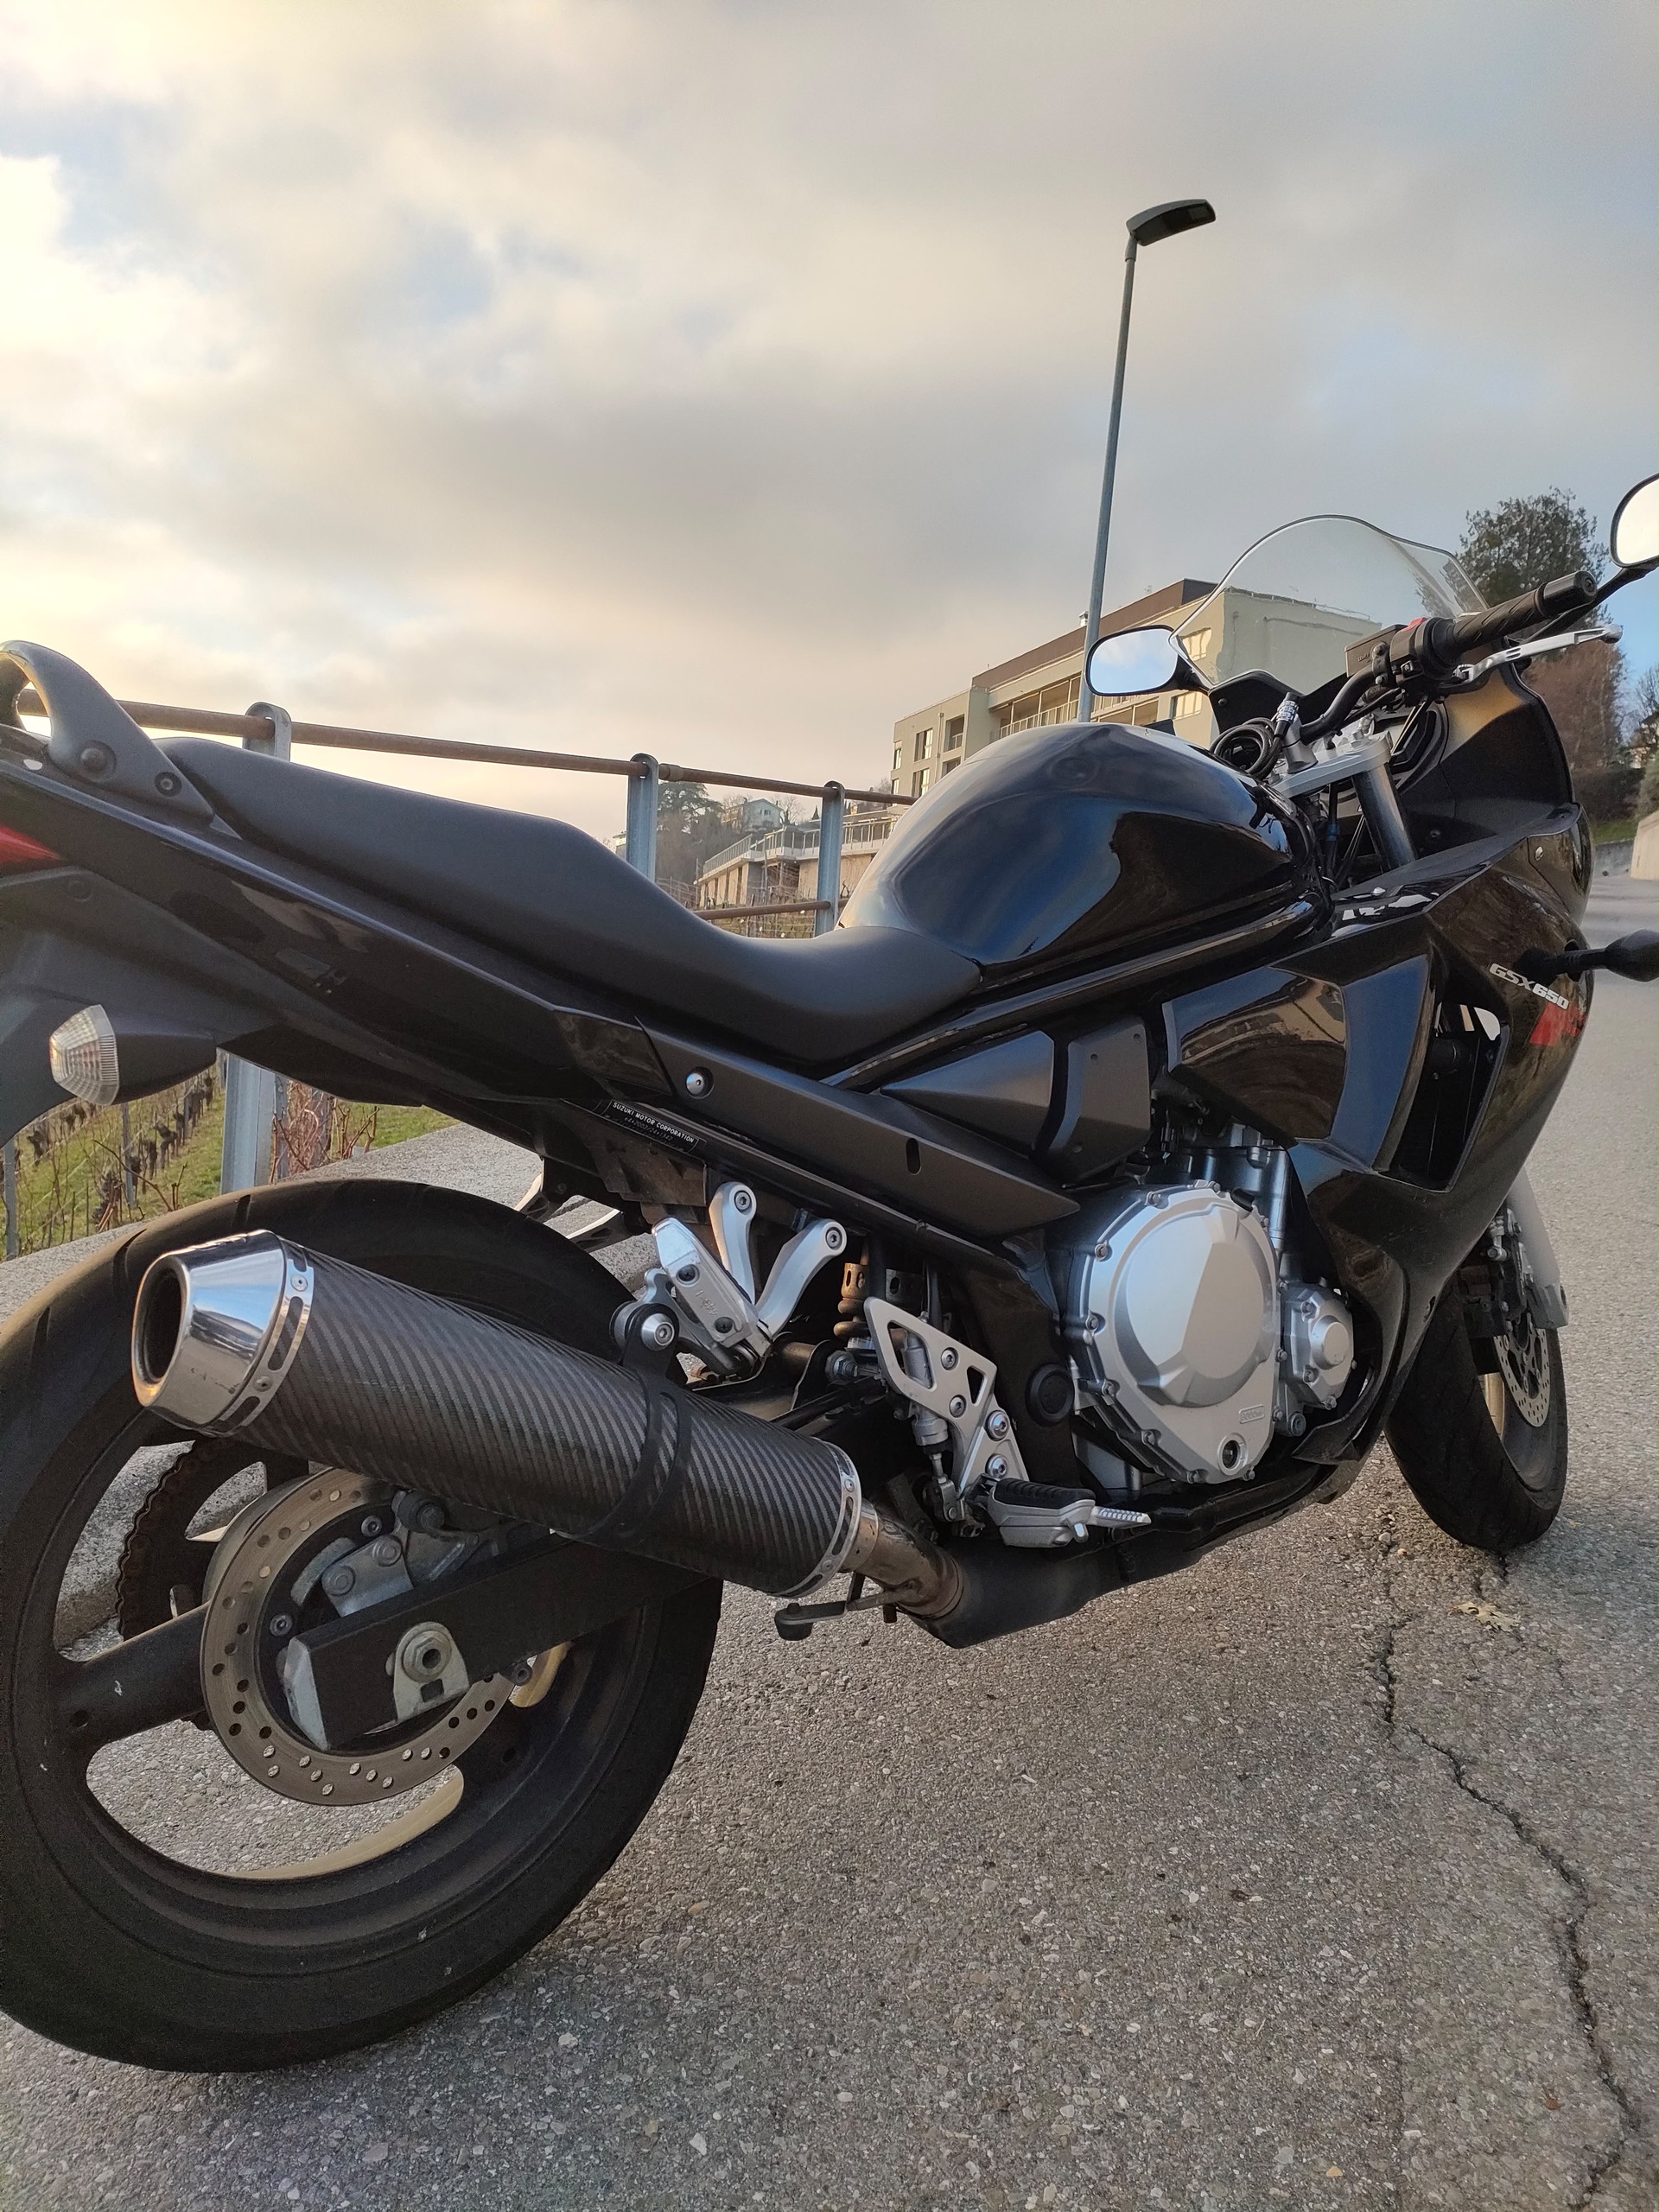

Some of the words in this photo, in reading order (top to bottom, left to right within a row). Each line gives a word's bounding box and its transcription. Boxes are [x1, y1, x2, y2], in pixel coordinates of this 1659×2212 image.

[613, 1102, 635, 1116] SUZUKI
[635, 1112, 656, 1126] MOTOR
[656, 1122, 695, 1143] CORPORATION
